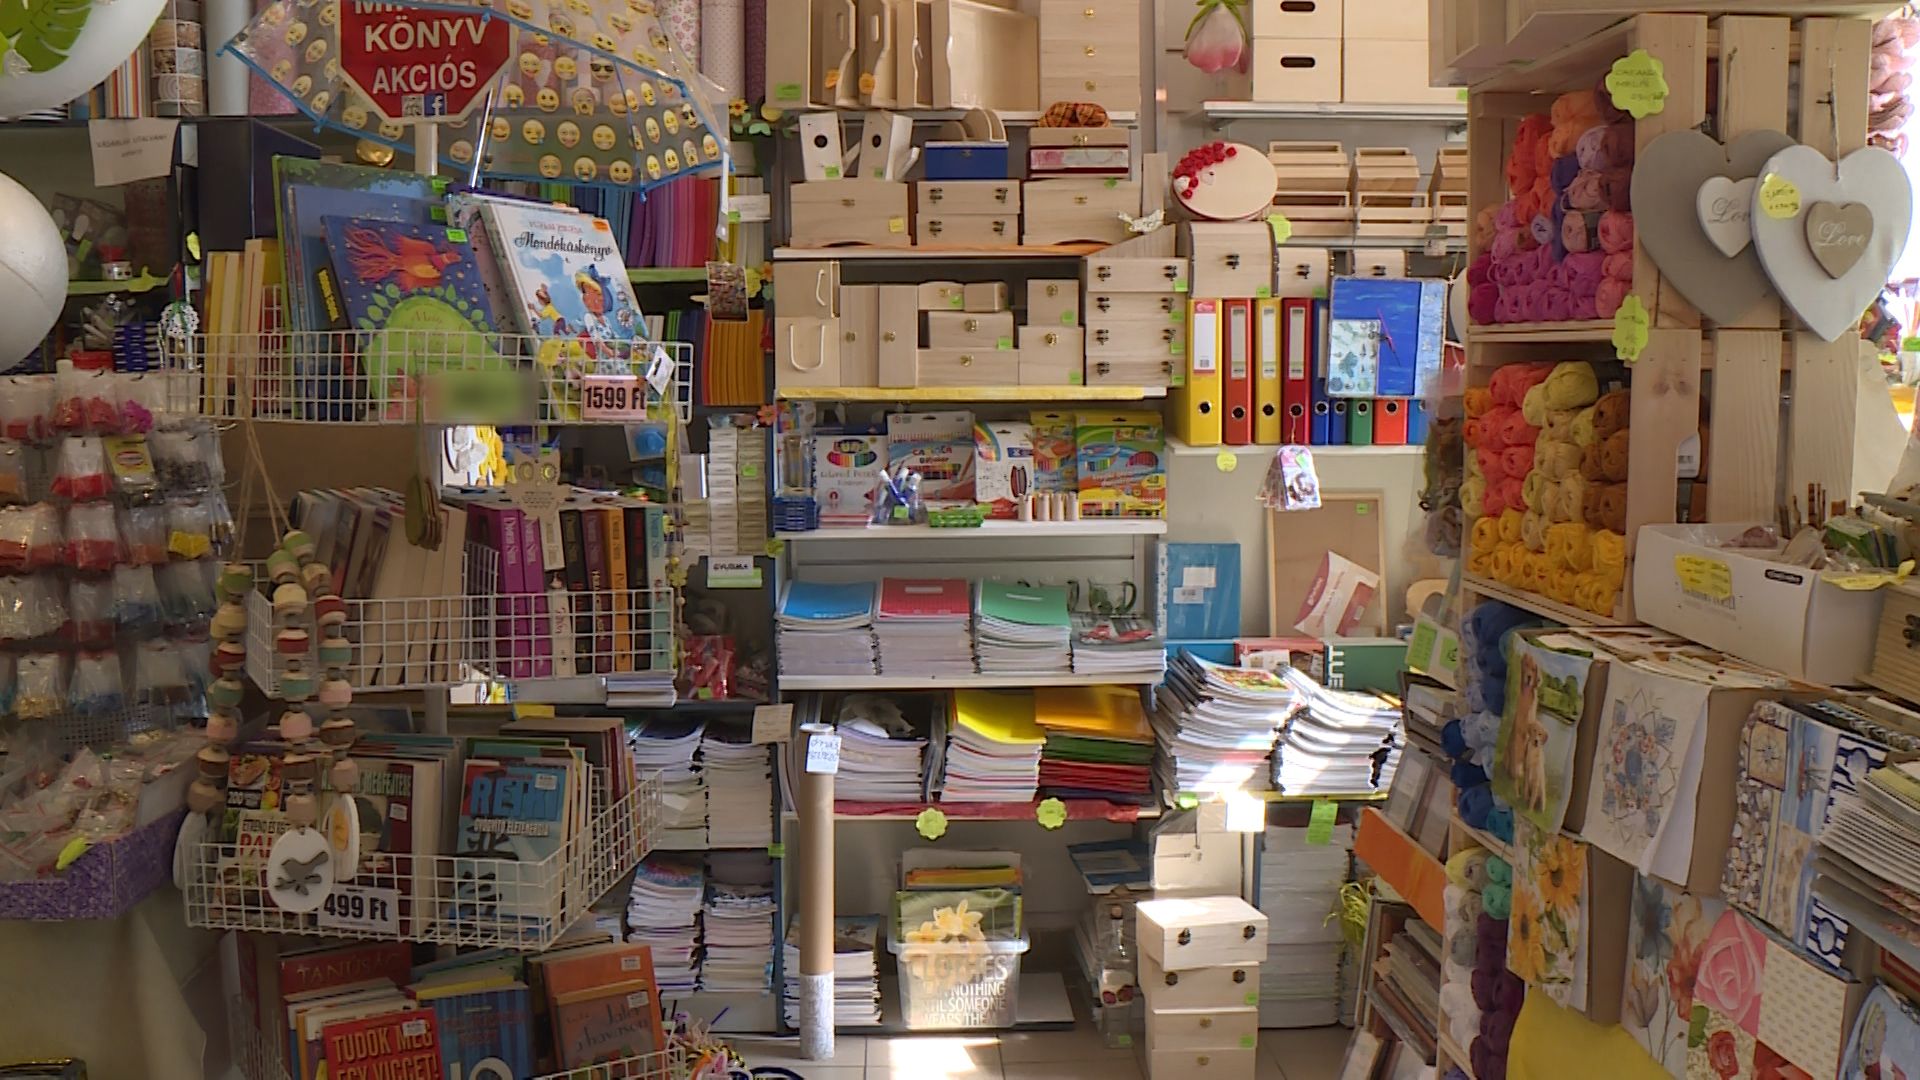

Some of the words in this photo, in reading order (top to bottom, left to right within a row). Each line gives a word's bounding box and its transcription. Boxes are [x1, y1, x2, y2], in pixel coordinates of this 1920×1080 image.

[364, 15, 491, 52] KÖNYV
[372, 53, 477, 95] AKCIÓS
[1815, 221, 1865, 247] Love
[584, 386, 626, 410] 1599
[631, 387, 645, 410] Ft
[324, 893, 364, 918] 499
[369, 897, 388, 921] Ft
[951, 981, 1006, 996] NOTHING
[948, 997, 1007, 1012] SOMEONE
[331, 1026, 391, 1063] TUDOK
